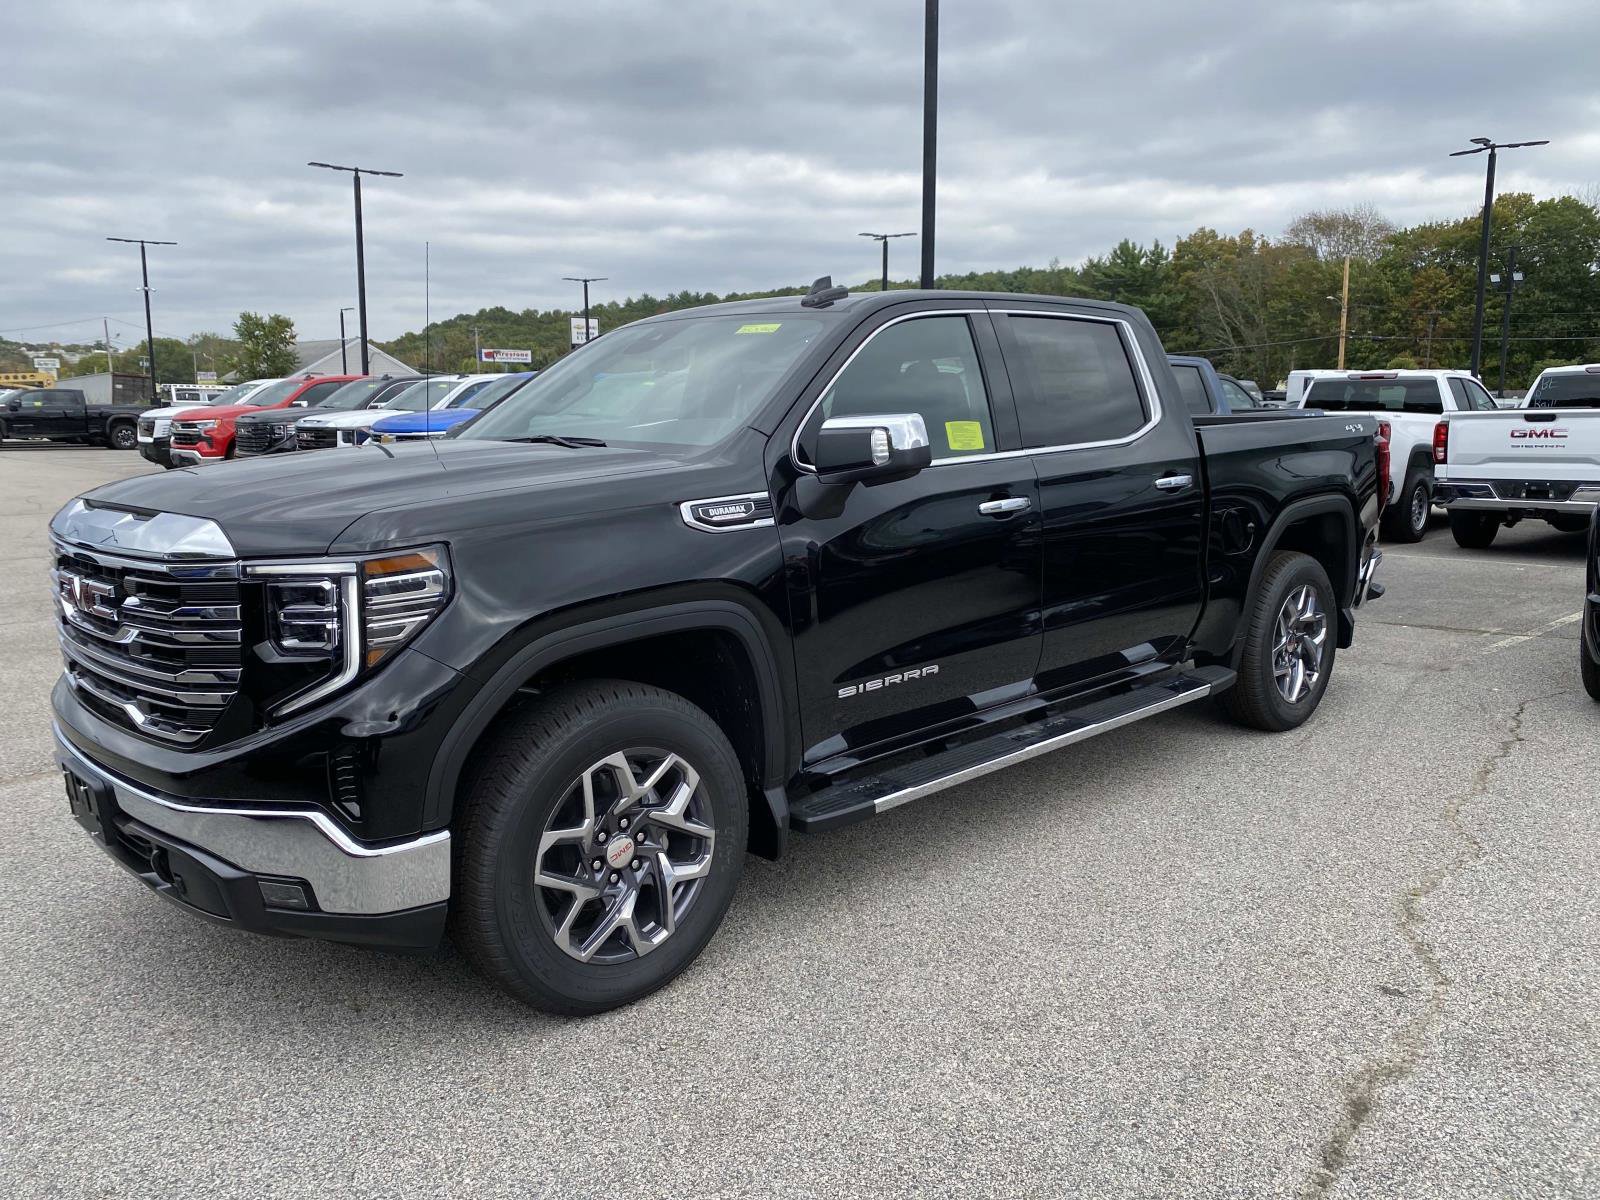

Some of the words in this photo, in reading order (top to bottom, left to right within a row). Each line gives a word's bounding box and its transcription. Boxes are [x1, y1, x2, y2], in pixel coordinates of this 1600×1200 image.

[1510, 429, 1568, 439] GMC
[708, 504, 746, 516] DURAMAX
[838, 664, 939, 699] SIERRA
[610, 842, 633, 862] GMC
